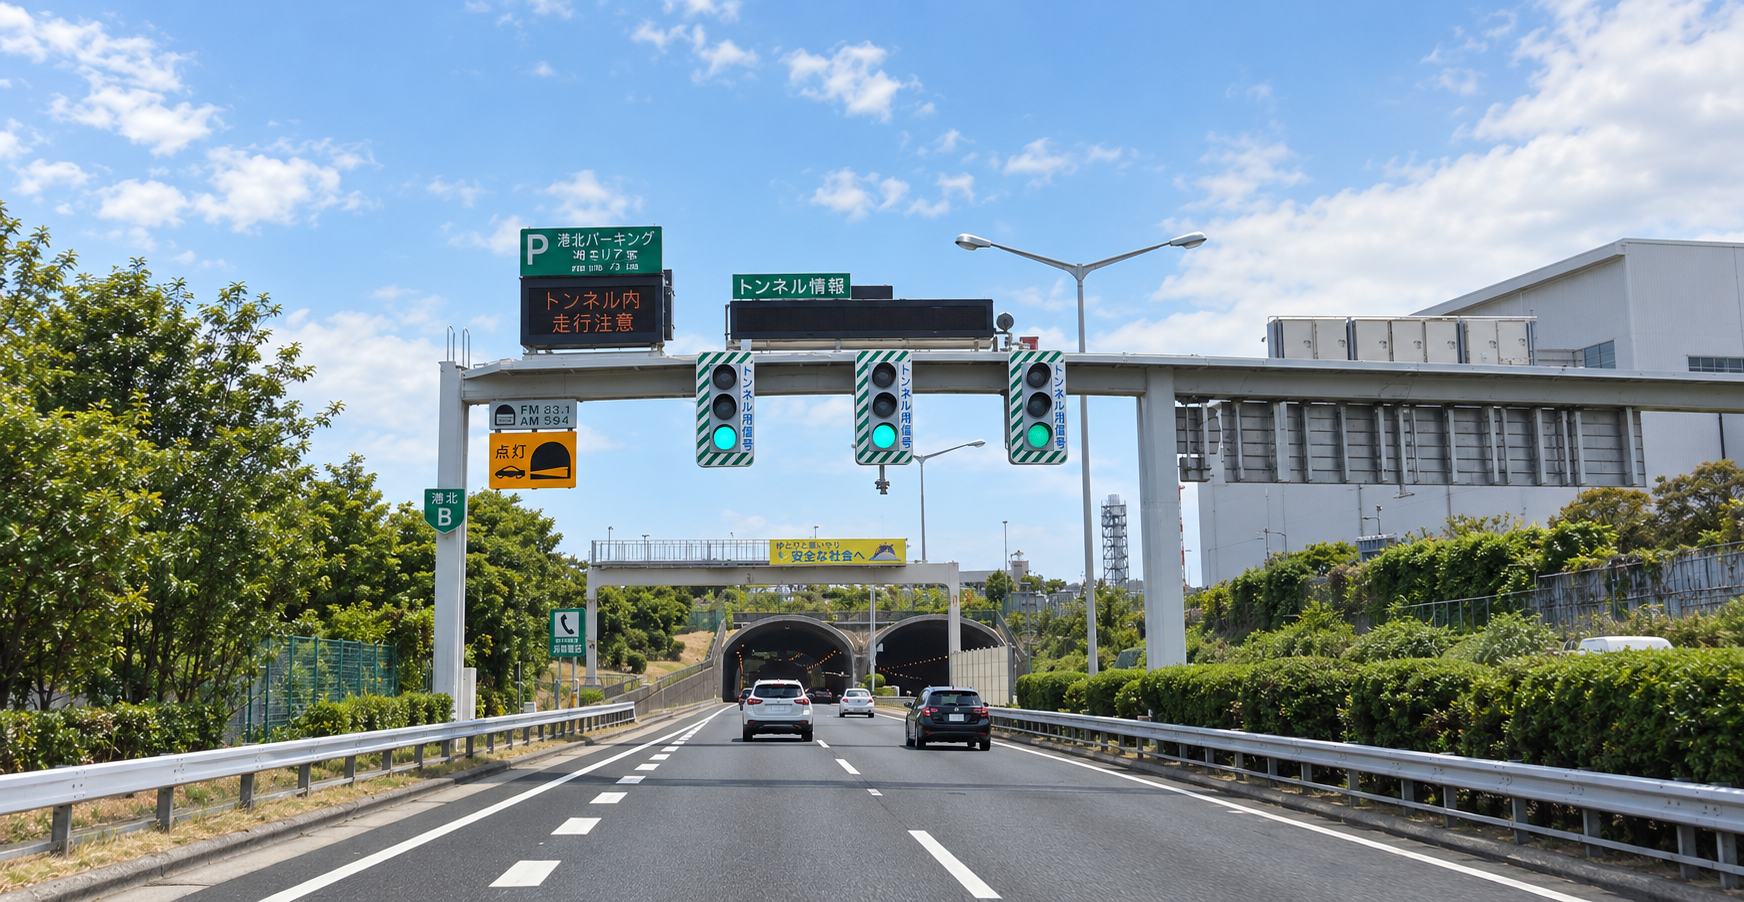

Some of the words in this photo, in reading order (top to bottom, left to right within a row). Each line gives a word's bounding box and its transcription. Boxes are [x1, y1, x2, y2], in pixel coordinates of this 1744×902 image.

[527, 234, 549, 265] P
[740, 278, 845, 295] トンネル情報
[547, 290, 640, 310] トンネル内
[552, 312, 634, 333] 走行注意
[520, 405, 539, 415] FM
[742, 365, 753, 451] トンネル用信号
[901, 364, 911, 449] トンネル用信号
[520, 416, 539, 426] AM
[495, 444, 527, 459] 点灯
[438, 507, 452, 526] B
[791, 550, 865, 563] 安全な社会へ
